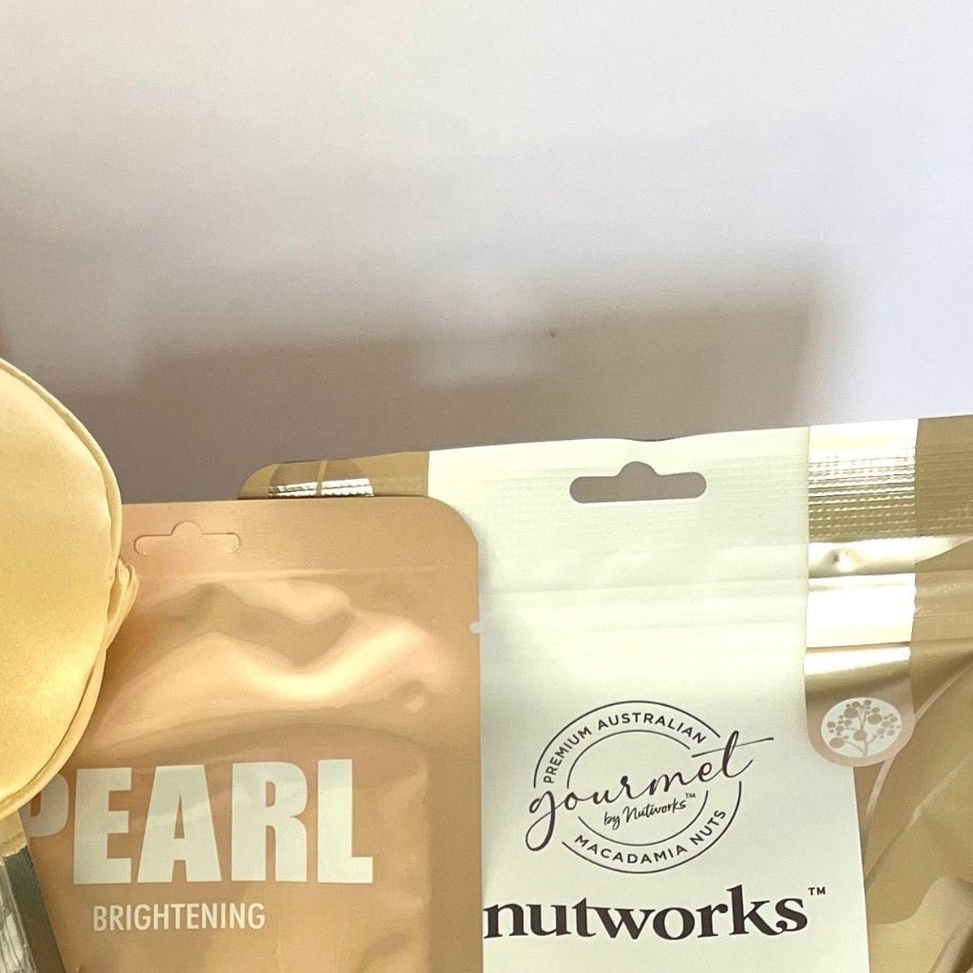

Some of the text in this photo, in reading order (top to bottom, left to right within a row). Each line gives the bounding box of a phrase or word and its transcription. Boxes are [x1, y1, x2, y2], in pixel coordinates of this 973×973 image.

[543, 712, 707, 784] PREMIUM AUSTRALIAN
[525, 730, 774, 852] gourmet
[574, 809, 726, 865] MACADAMIA NUTS
[604, 811, 621, 830] by
[92, 902, 266, 932] BRIGHTENING
